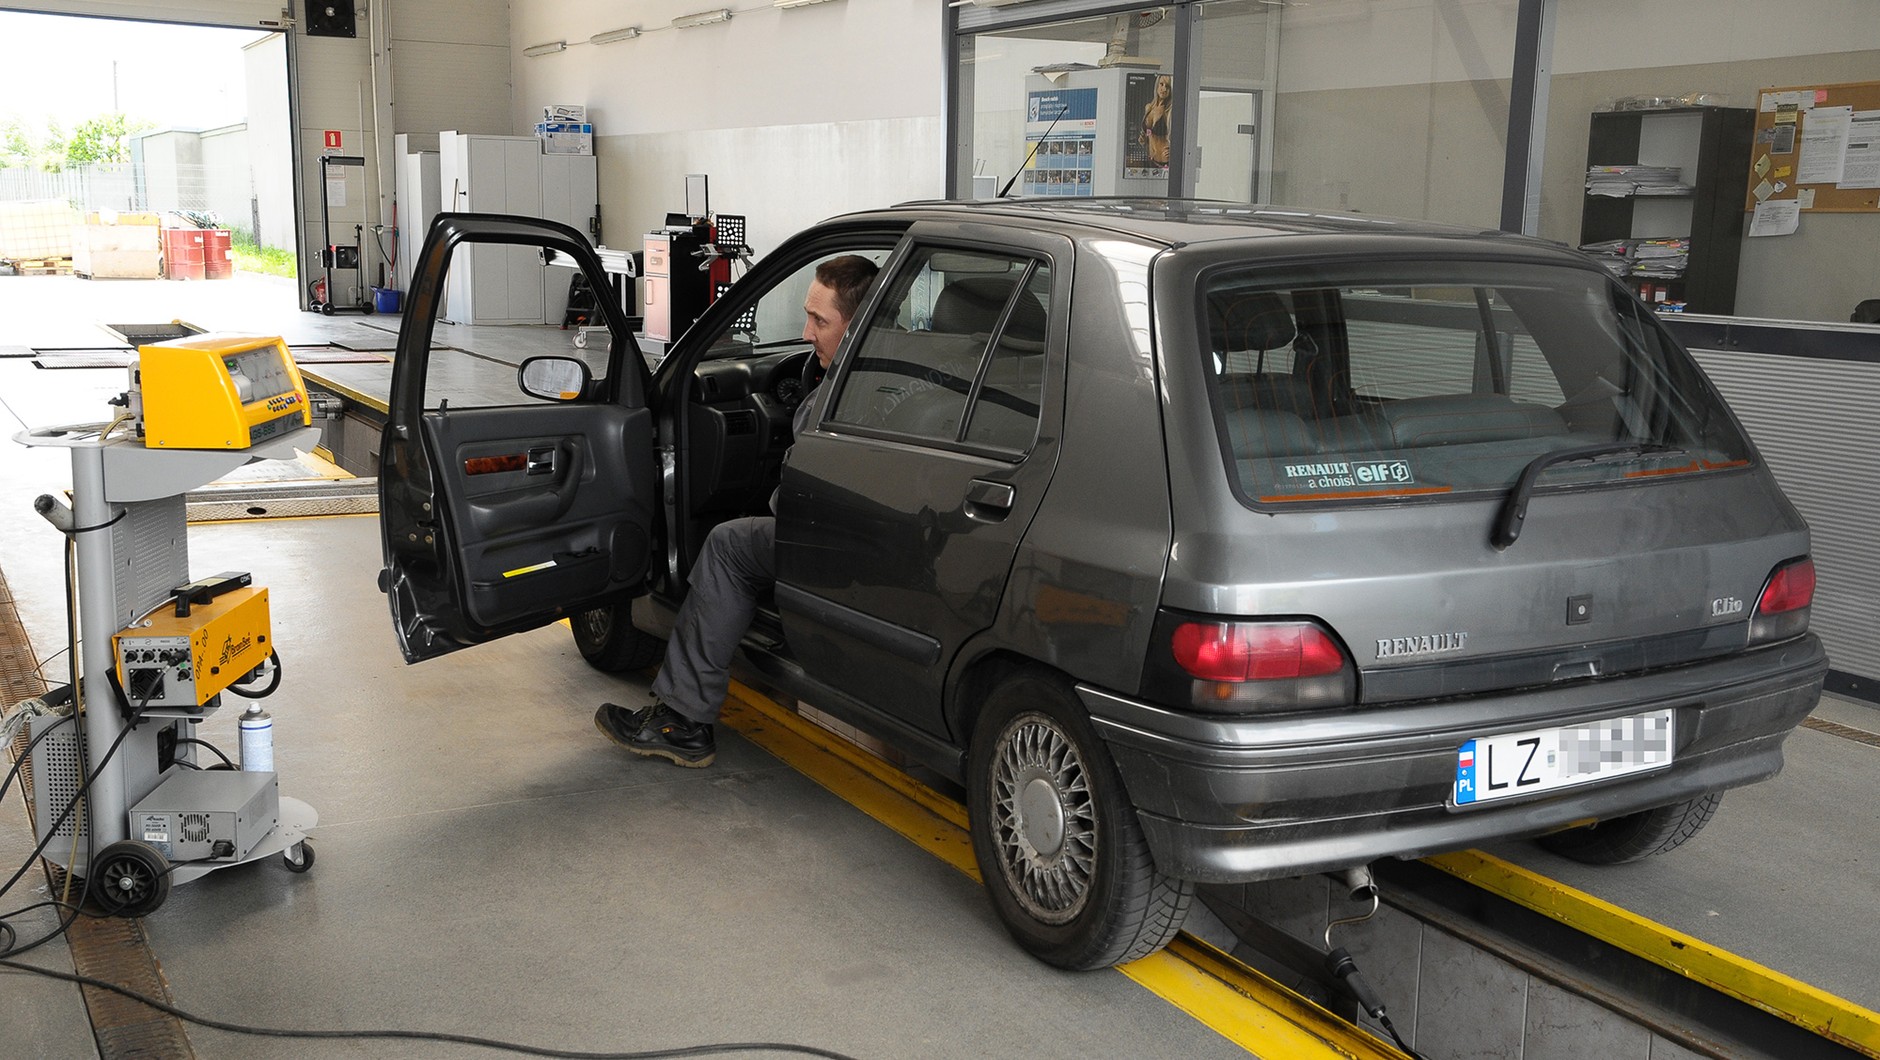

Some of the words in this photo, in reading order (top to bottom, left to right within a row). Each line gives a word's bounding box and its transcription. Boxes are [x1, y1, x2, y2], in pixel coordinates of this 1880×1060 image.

[1285, 462, 1349, 478] RENAULT
[1357, 464, 1390, 482] elf
[1308, 479, 1318, 489] a
[1318, 474, 1356, 488] choisi
[1712, 598, 1743, 616] Clio
[1376, 631, 1468, 659] RENAULT
[1488, 737, 1541, 791] LZ
[1459, 778, 1474, 793] PL
